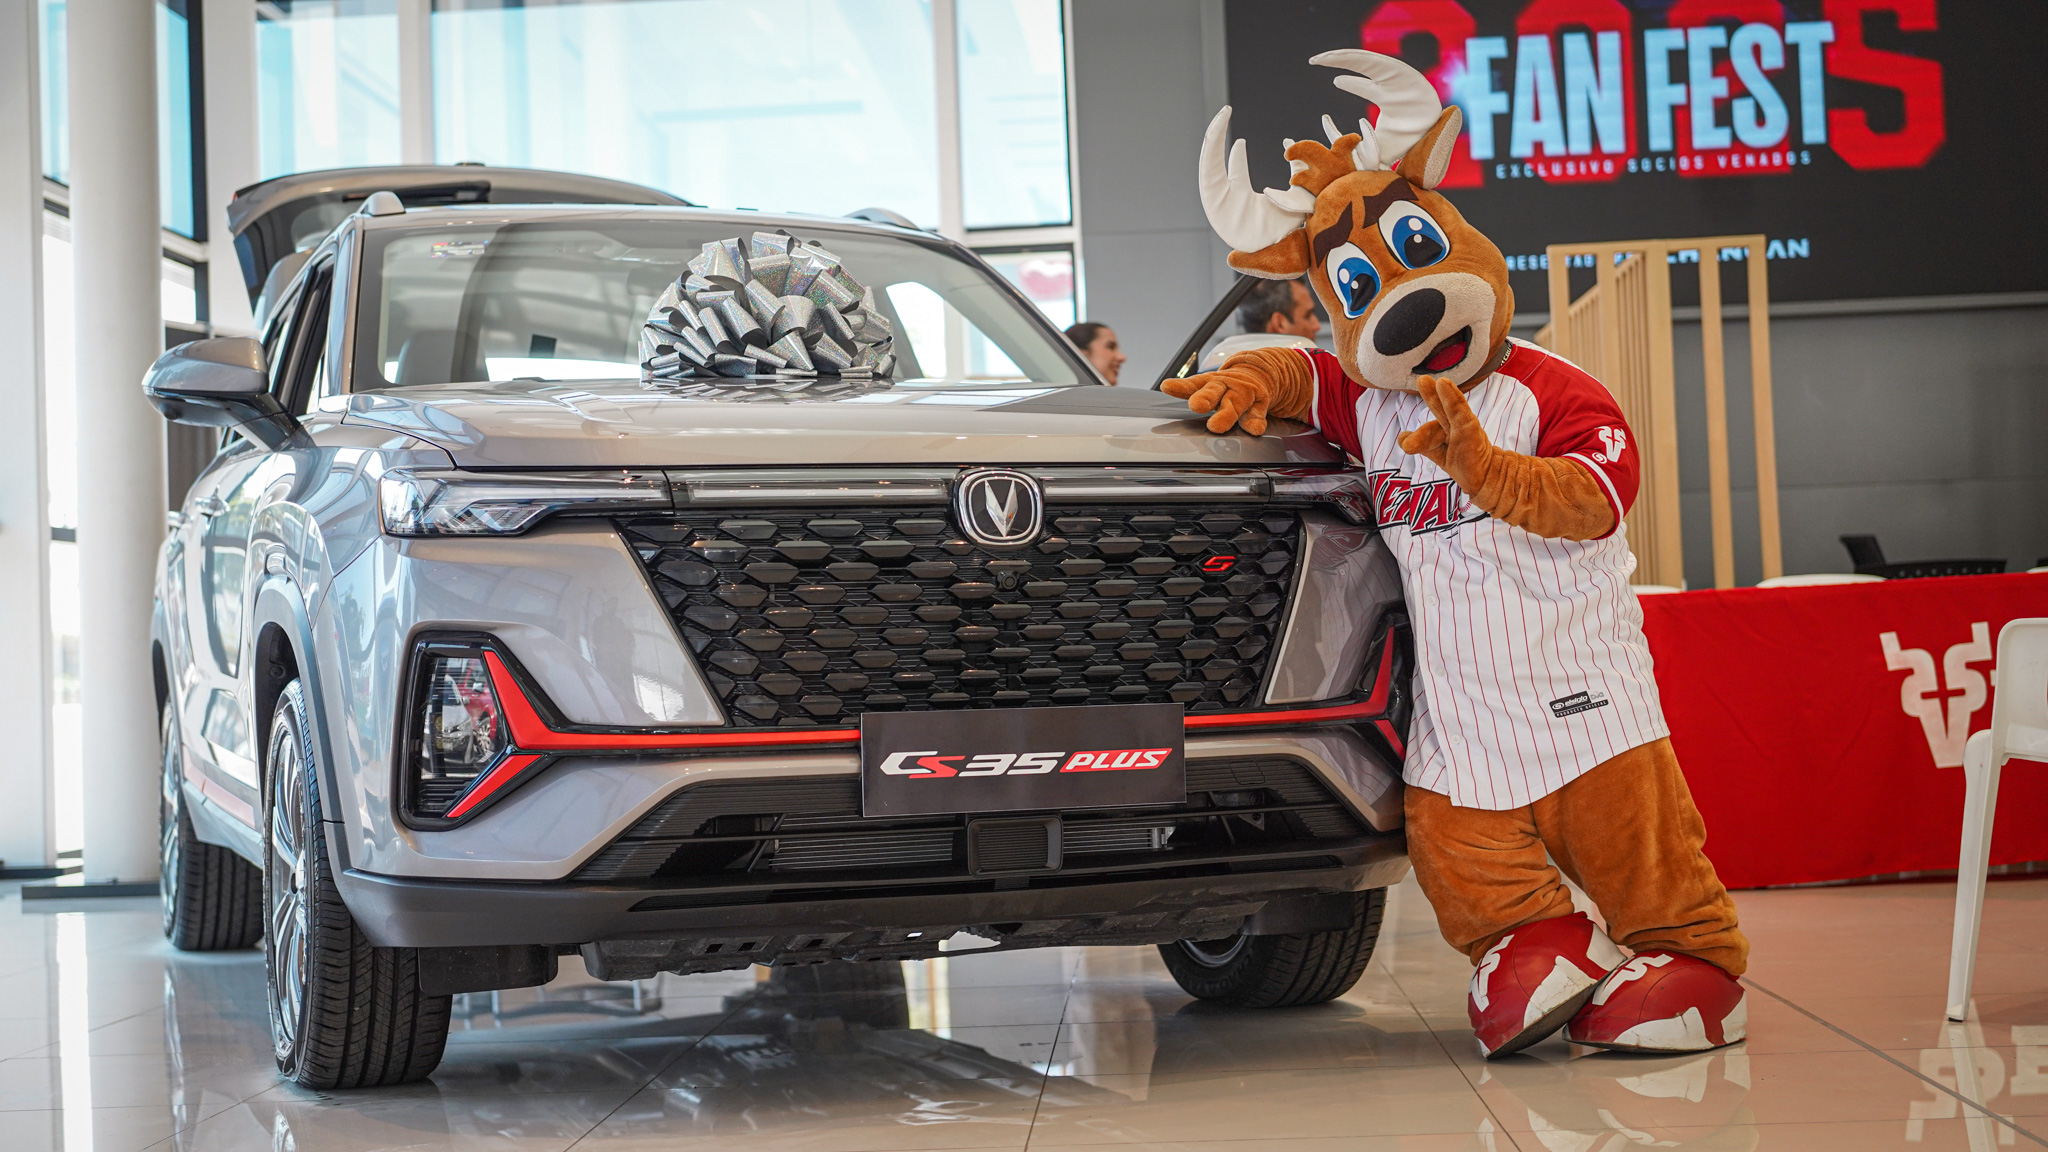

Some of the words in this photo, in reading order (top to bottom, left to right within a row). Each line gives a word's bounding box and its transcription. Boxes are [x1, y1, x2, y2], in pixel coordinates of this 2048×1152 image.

[1466, 31, 1626, 161] FAN
[1643, 21, 1835, 153] FEST
[1496, 159, 1615, 179] EXCLUSIVO
[1627, 156, 1704, 173] SOCIOS
[1717, 150, 1812, 169] VENADOS
[880, 750, 1066, 779] CS35
[1065, 750, 1168, 770] PLUS
